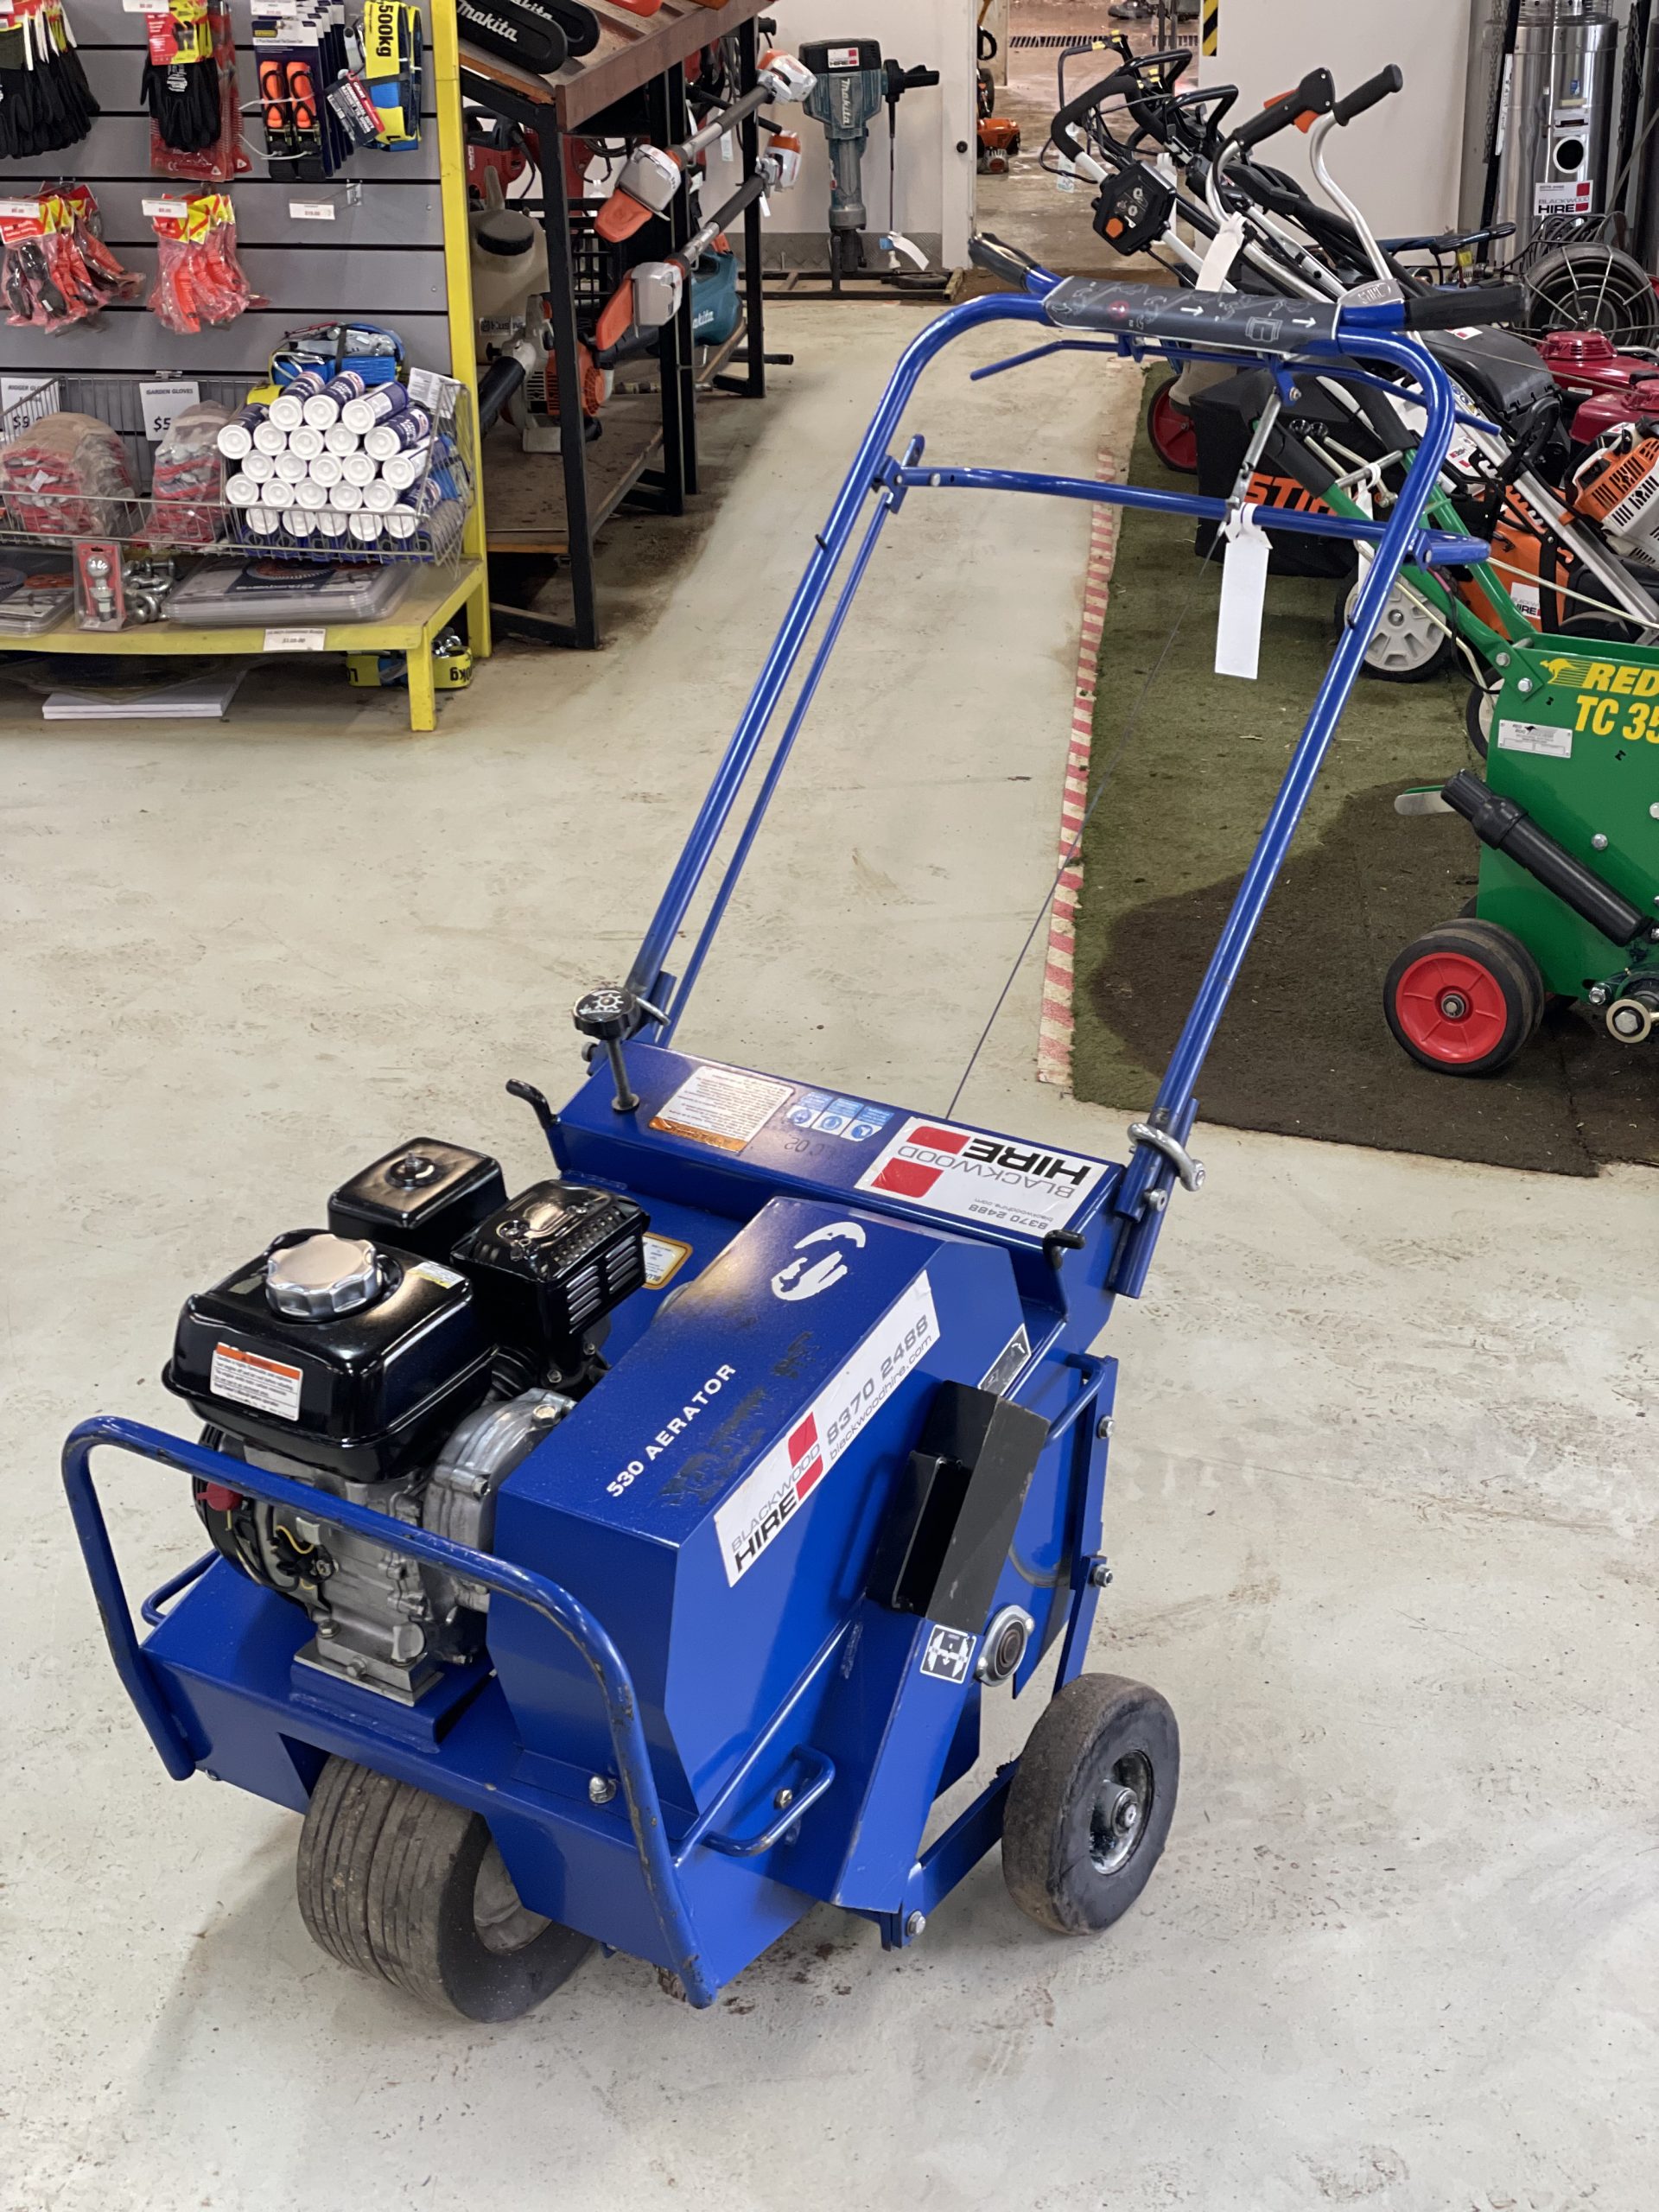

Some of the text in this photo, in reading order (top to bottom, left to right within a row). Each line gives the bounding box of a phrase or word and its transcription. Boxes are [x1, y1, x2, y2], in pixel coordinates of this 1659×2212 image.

[1538, 203, 1574, 214] HIRE
[1575, 695, 1619, 735] TC
[897, 1145, 1076, 1199] BLACKWOOD
[962, 1137, 1092, 1186] HIRE
[968, 1203, 1050, 1230] 8370 2488
[606, 1363, 736, 1497] 530 AERATOR
[730, 1313, 929, 1553] BLACKWOOD 8370 2488
[734, 1334, 932, 1573] HIRE blackwoodhire.com
